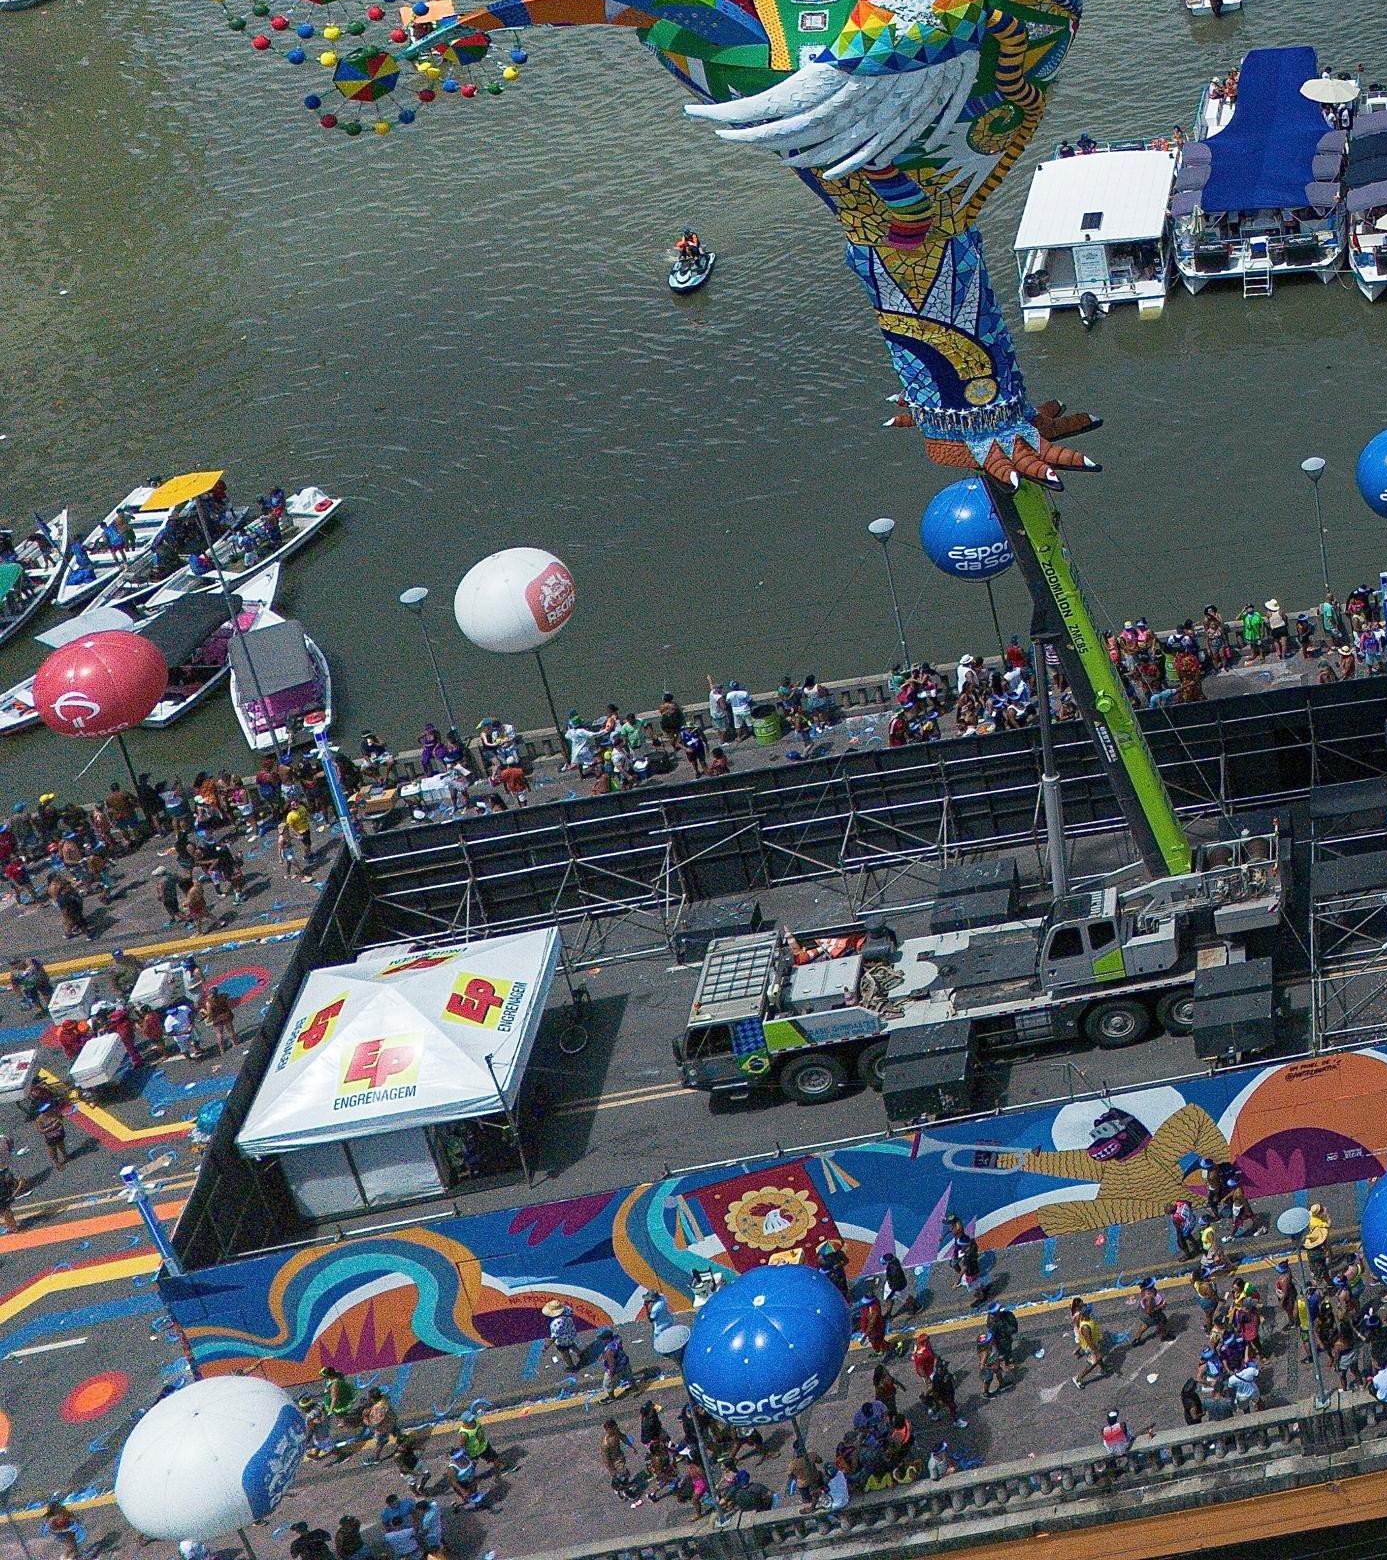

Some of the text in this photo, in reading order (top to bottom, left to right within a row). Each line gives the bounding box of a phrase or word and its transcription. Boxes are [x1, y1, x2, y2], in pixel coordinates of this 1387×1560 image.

[948, 540, 1011, 561] Espor
[1041, 561, 1088, 655] ZOOMLION ZMC85
[446, 978, 504, 1024] EP
[497, 981, 528, 1033] ENGRENAGEM
[344, 1038, 416, 1089] EP
[333, 1085, 416, 1111] ENGRENAGEM
[688, 1374, 819, 1418] Esportes
